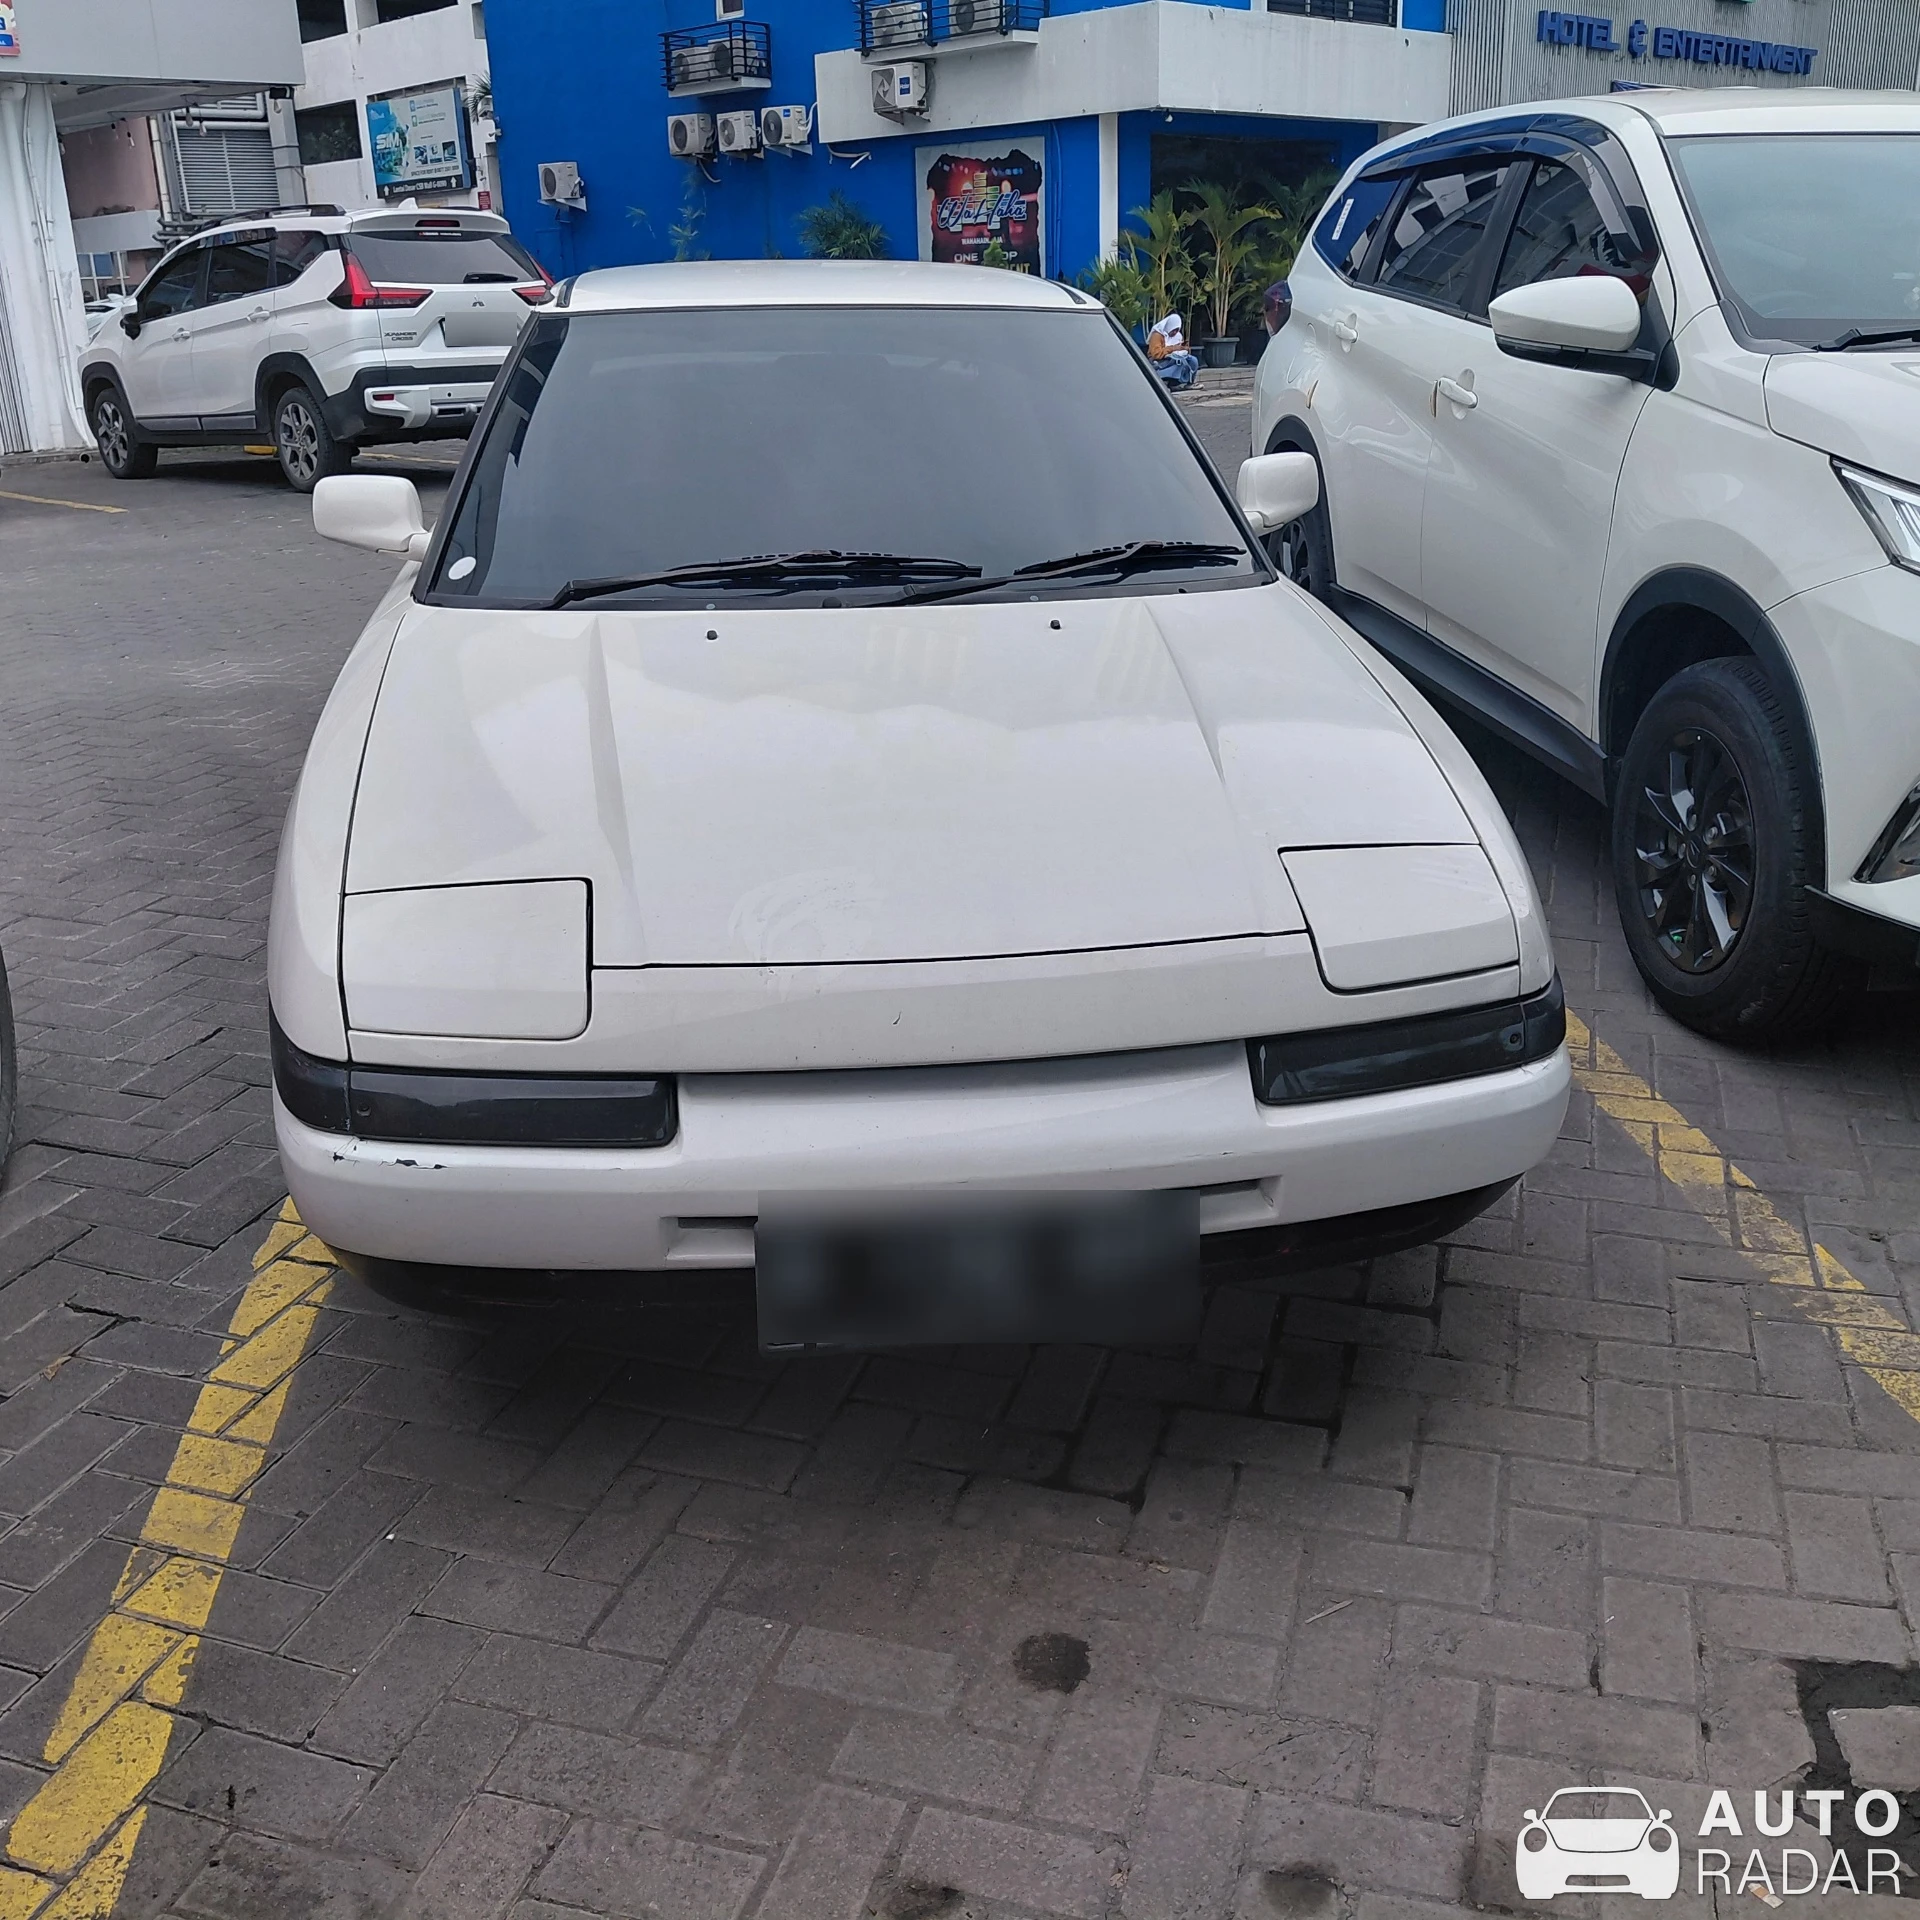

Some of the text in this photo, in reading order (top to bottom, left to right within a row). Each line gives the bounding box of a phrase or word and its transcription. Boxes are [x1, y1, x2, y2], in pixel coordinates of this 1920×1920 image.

[1538, 10, 1818, 75] HOTEL & ENTERTAINMENT
[376, 132, 400, 150] SIM
[954, 253, 979, 263] ONE
